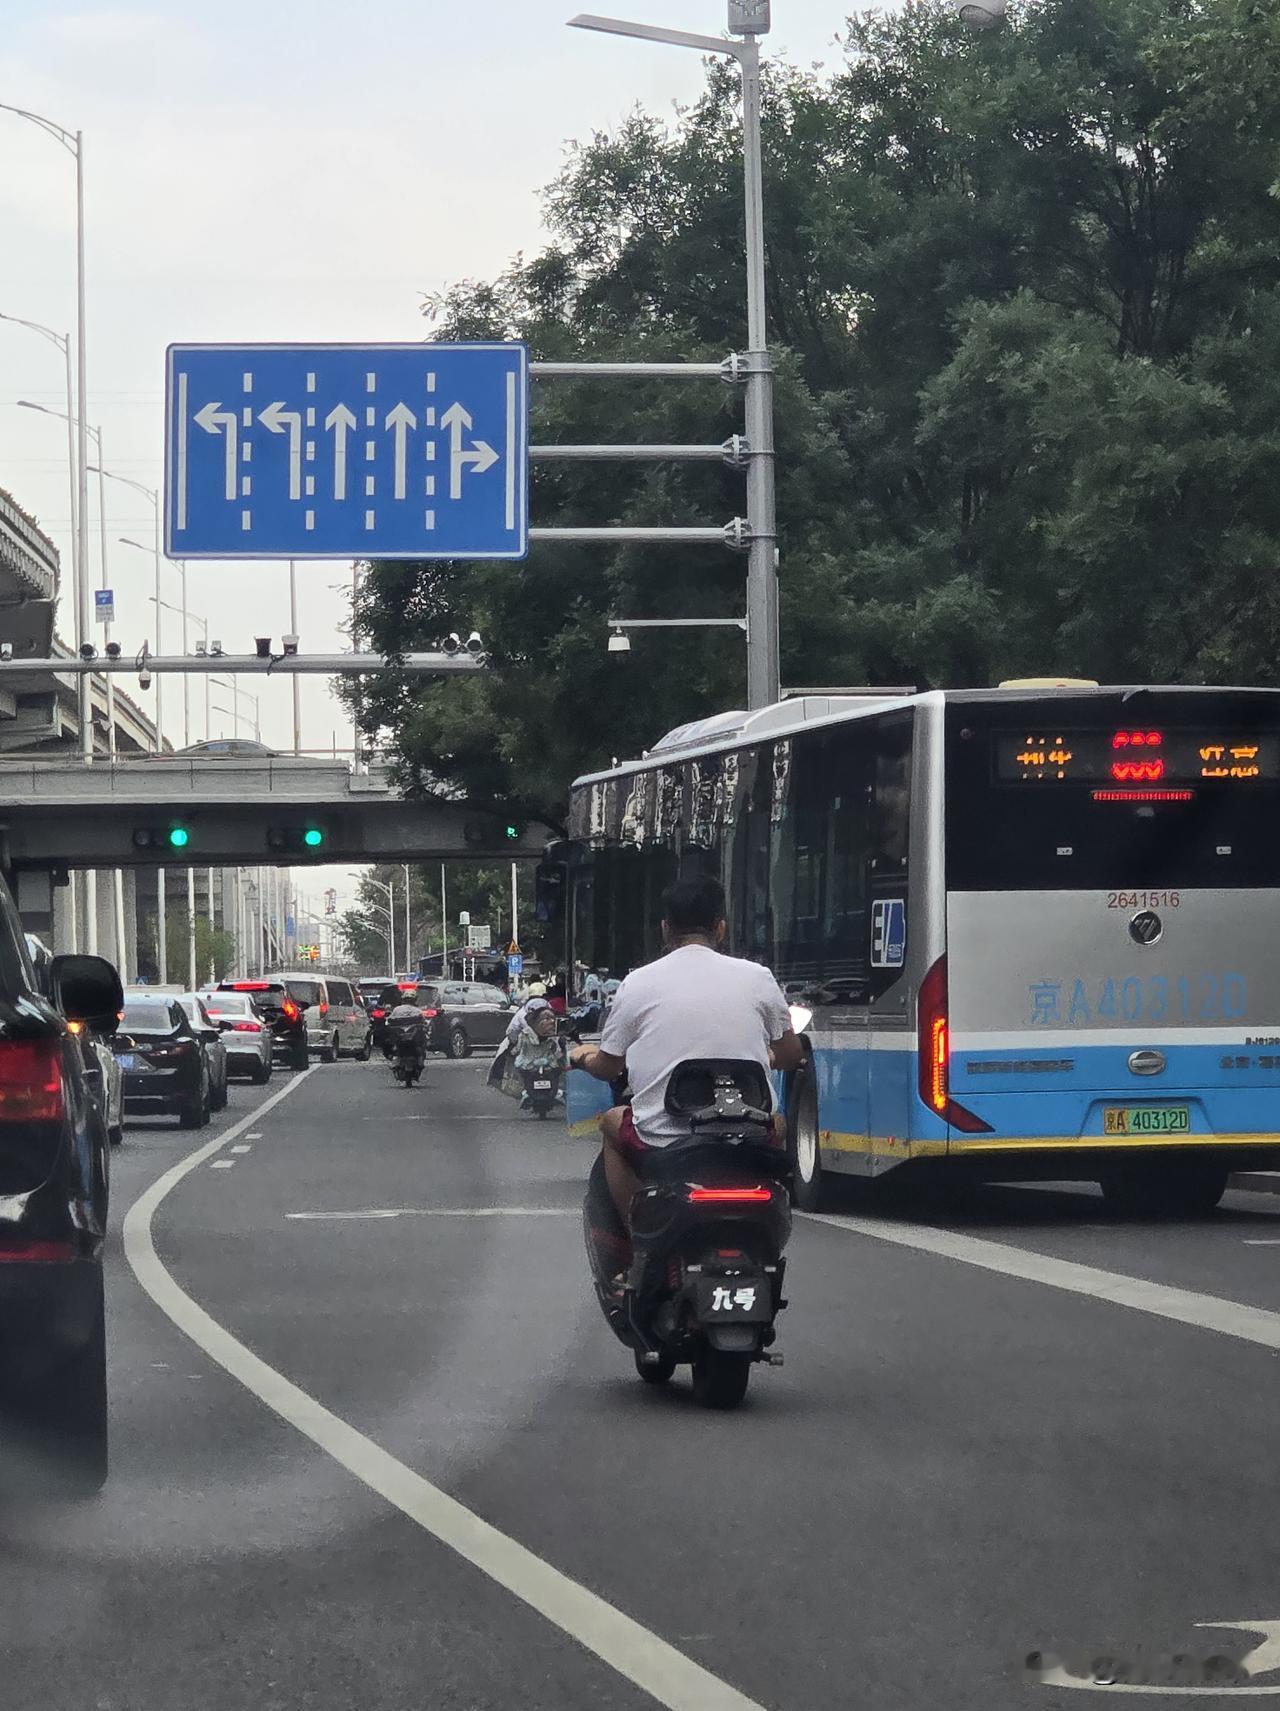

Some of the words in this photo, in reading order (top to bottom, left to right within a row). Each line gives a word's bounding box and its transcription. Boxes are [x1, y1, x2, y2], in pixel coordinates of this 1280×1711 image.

[1107, 891, 1180, 909] 2641516
[1028, 972, 1248, 1025] 京A40312D
[712, 1286, 757, 1312] 九号
